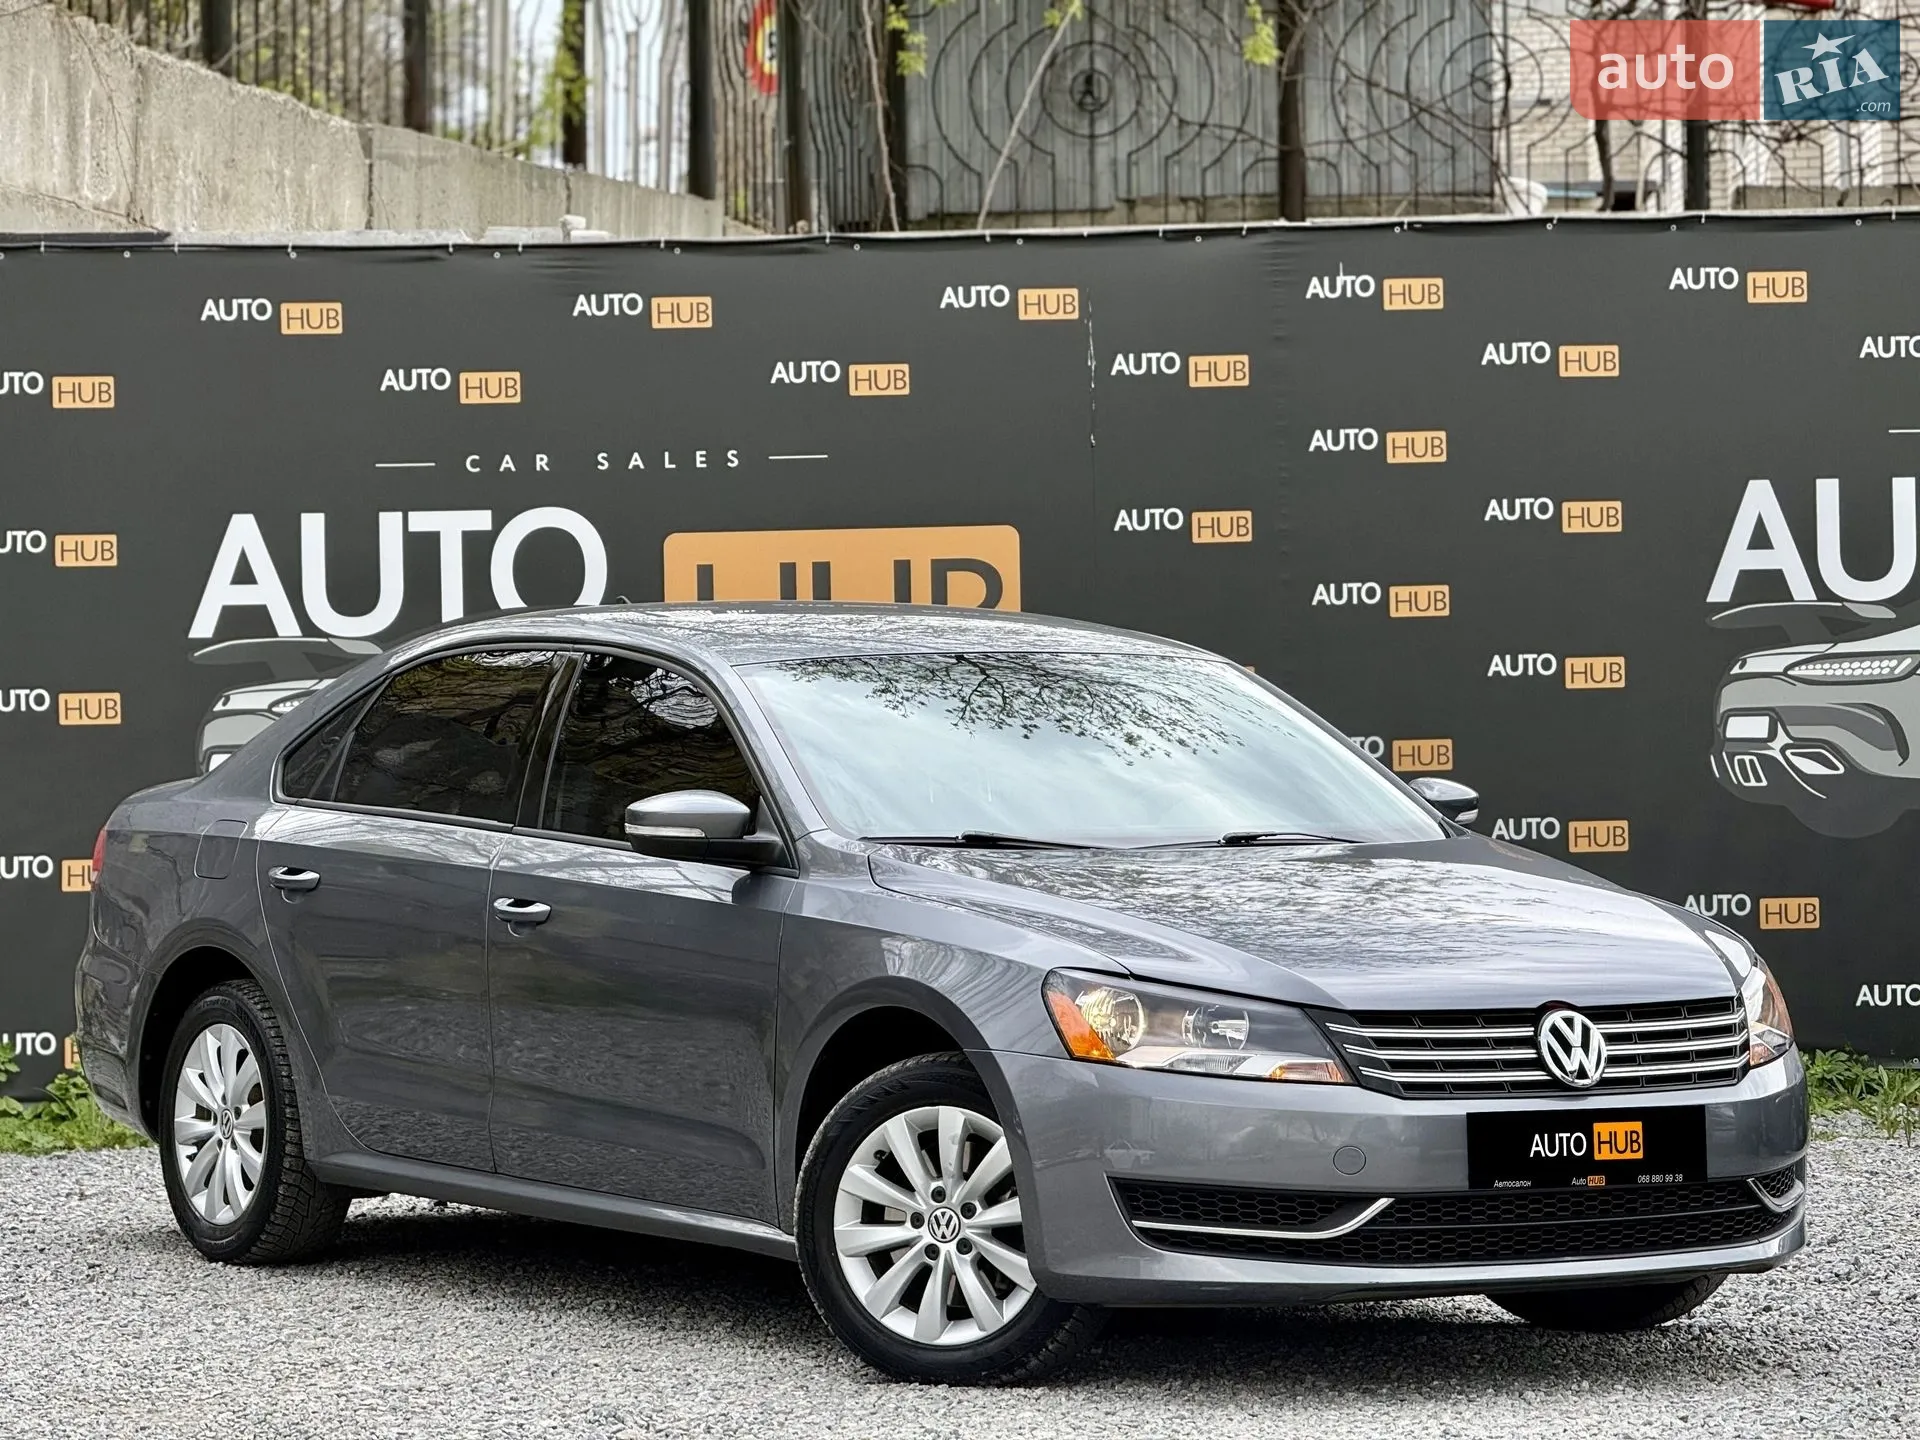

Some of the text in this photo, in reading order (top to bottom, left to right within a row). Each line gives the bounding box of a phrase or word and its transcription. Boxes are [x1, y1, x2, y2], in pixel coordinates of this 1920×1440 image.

[1306, 274, 1440, 305] AUTO HUB
[1669, 267, 1804, 298] AUTO HUB
[201, 298, 339, 330] AUTO HUB
[573, 292, 709, 323] AUTO HUB
[940, 285, 1075, 315] AUTO HUB
[1111, 352, 1246, 382] AUTO HUB
[1482, 341, 1616, 372] AUTO HUB
[0, 372, 111, 404] UTO HUB
[380, 368, 517, 399] AUTO HUB
[771, 361, 906, 391] AUTO HUB
[1309, 428, 1443, 458] AUTO HUB
[466, 450, 738, 472] CAR SALES
[1114, 508, 1249, 538] AUTO HUB
[1485, 498, 1619, 528] AUTO HUB
[0, 530, 114, 562] UTO HUB
[1706, 477, 1916, 602] AU
[188, 507, 607, 638] AUTO
[1312, 582, 1446, 613] AUTO HUB
[1488, 653, 1622, 684] AUTO HUB
[0, 689, 117, 720] UTO HUB
[1350, 735, 1449, 767] TO HUB
[1491, 817, 1626, 848] AUTO HUB
[0, 855, 53, 879] UTO
[1684, 894, 1817, 925] AUTO HUB
[1856, 984, 1920, 1007] AUTO
[3, 1032, 57, 1055] UTO
[1530, 1130, 1641, 1158] AUTO HUB
[1571, 1176, 1604, 1186] Auto HUB
[1637, 1175, 1650, 1183] 068
